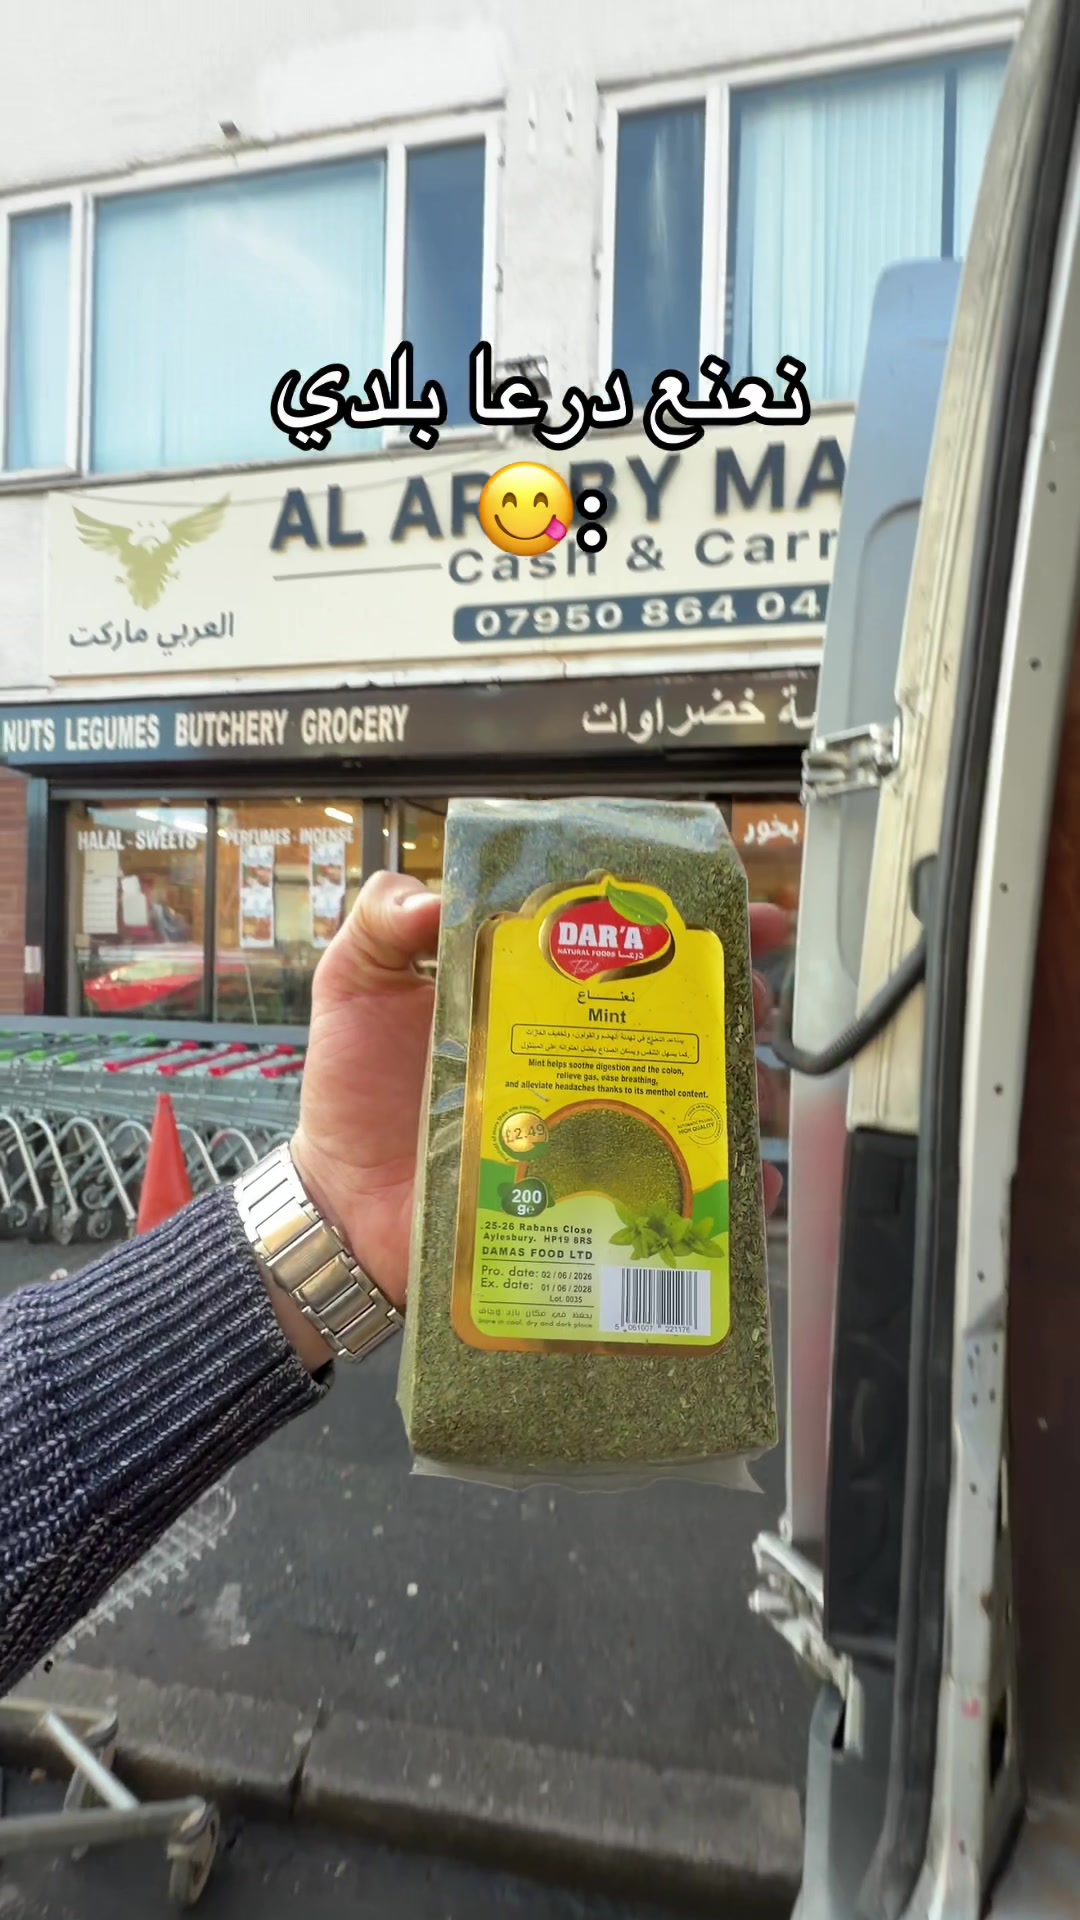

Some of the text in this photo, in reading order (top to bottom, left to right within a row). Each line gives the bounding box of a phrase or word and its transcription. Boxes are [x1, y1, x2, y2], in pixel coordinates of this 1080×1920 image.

[270, 484, 367, 553] AL
[390, 454, 682, 543] ARBY
[448, 538, 598, 585] Cash
[626, 534, 665, 573] &
[475, 602, 623, 638] 07950
[641, 594, 737, 628] 864
[69, 611, 235, 657] العربي ماركت
[581, 687, 766, 744] خضراوات
[2, 704, 409, 753] NUTS LEGUMES BUTCHERY GROCERY
[78, 830, 125, 851] HALAL
[135, 825, 198, 850] SWEETS
[743, 814, 799, 846] بخور
[558, 921, 644, 950] DAR'A
[557, 948, 616, 959] NATURAL FOODS
[588, 1008, 627, 1024] Mint
[528, 1058, 545, 1067] Mint
[547, 1060, 567, 1070] helps
[569, 1061, 594, 1070] soothe
[596, 1063, 630, 1073] digestion
[632, 1065, 646, 1073] and
[648, 1065, 660, 1074] the
[556, 1071, 582, 1080] relieve
[505, 1080, 519, 1088] and
[521, 1080, 553, 1089] alleviate
[555, 1082, 596, 1092] headaches
[597, 1084, 623, 1094] thanks
[634, 1087, 644, 1095] its
[646, 1088, 676, 1097] menthol
[678, 1090, 709, 1099] content.
[505, 1123, 545, 1144] £2.49
[511, 1189, 542, 1204] 200
[519, 1223, 559, 1233] Rabans
[563, 1225, 593, 1234] Close
[543, 1235, 570, 1244] HP19
[573, 1237, 593, 1245] 8RS
[482, 1246, 593, 1260] DAMAS FOOD LTD
[481, 1265, 504, 1276] Pro.
[509, 1266, 539, 1278] date:
[481, 1277, 499, 1289] Ex.
[503, 1278, 534, 1290] date:
[526, 1319, 538, 1328] dry
[540, 1320, 554, 1328] and
[555, 1320, 572, 1328] dark
[573, 1322, 593, 1330] place
